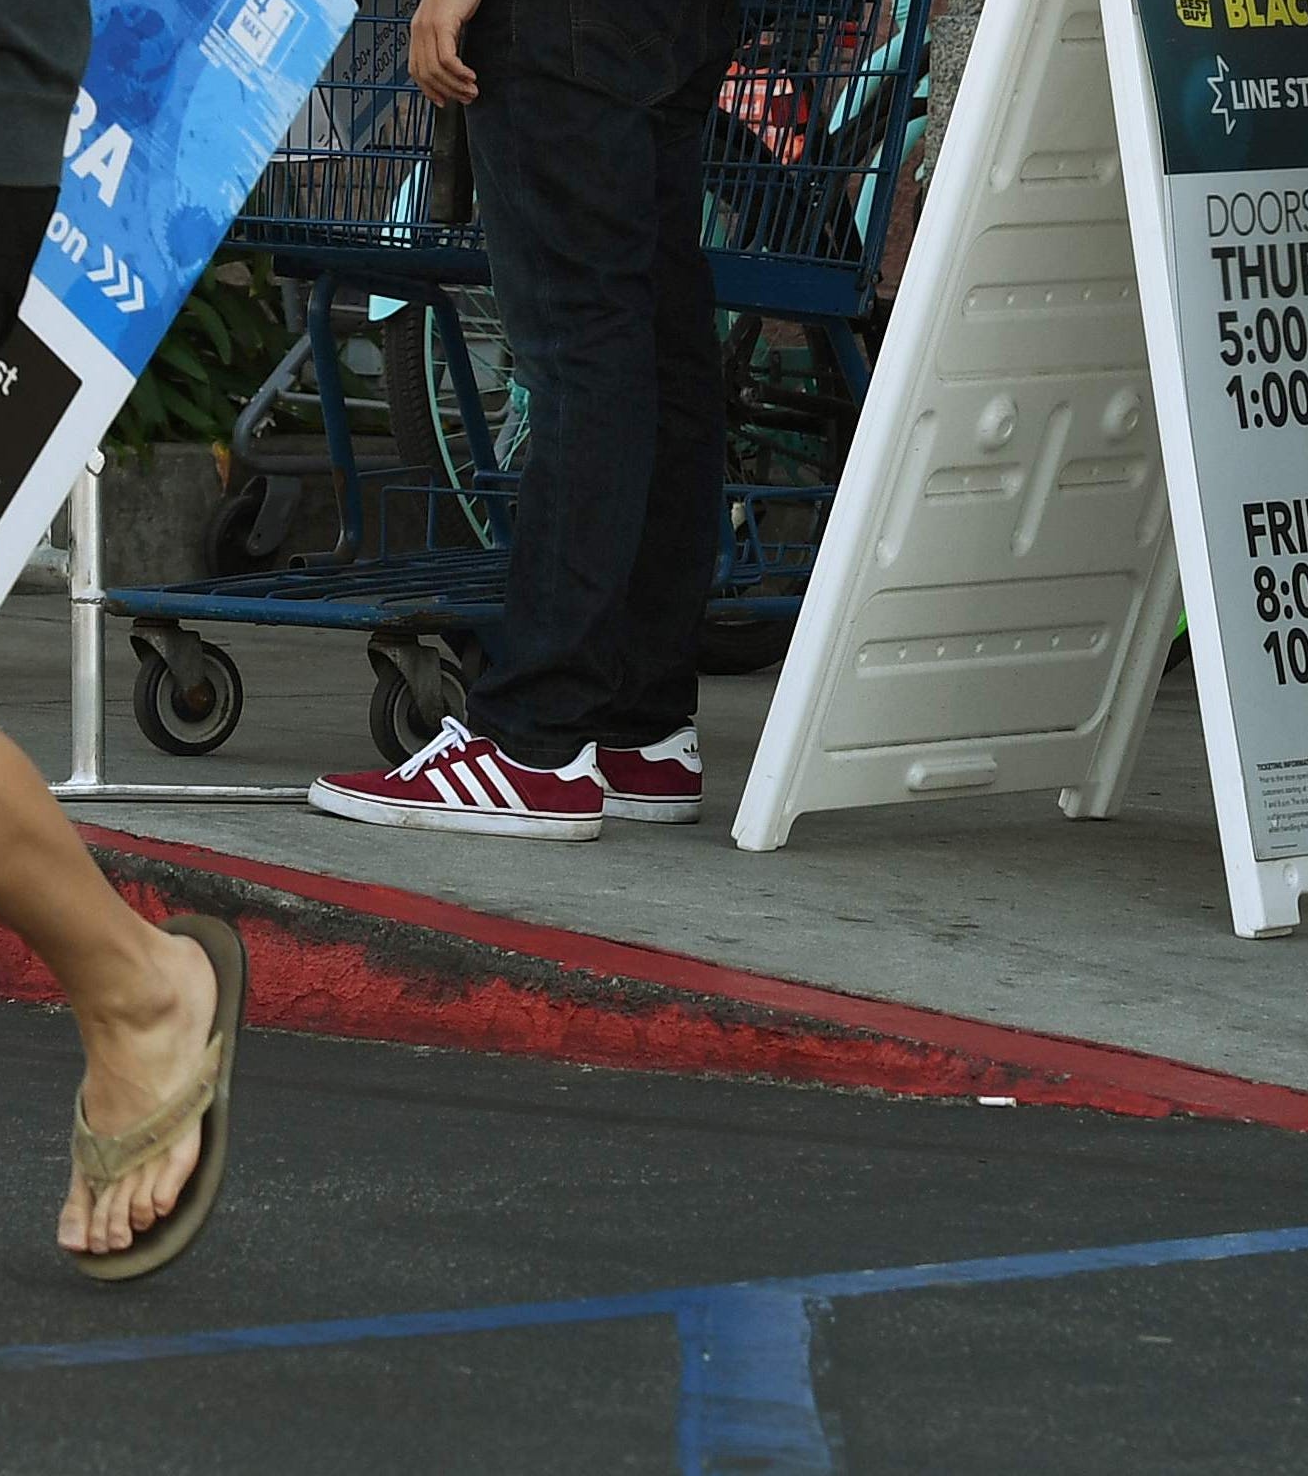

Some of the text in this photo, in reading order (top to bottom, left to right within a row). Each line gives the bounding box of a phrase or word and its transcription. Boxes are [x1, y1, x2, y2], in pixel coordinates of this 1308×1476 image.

[1183, 9, 1207, 22] BUY
[1230, 77, 1281, 110] LINE
[64, 85, 133, 208] BA
[45, 210, 89, 264] on
[1218, 302, 1308, 367] 5:00
